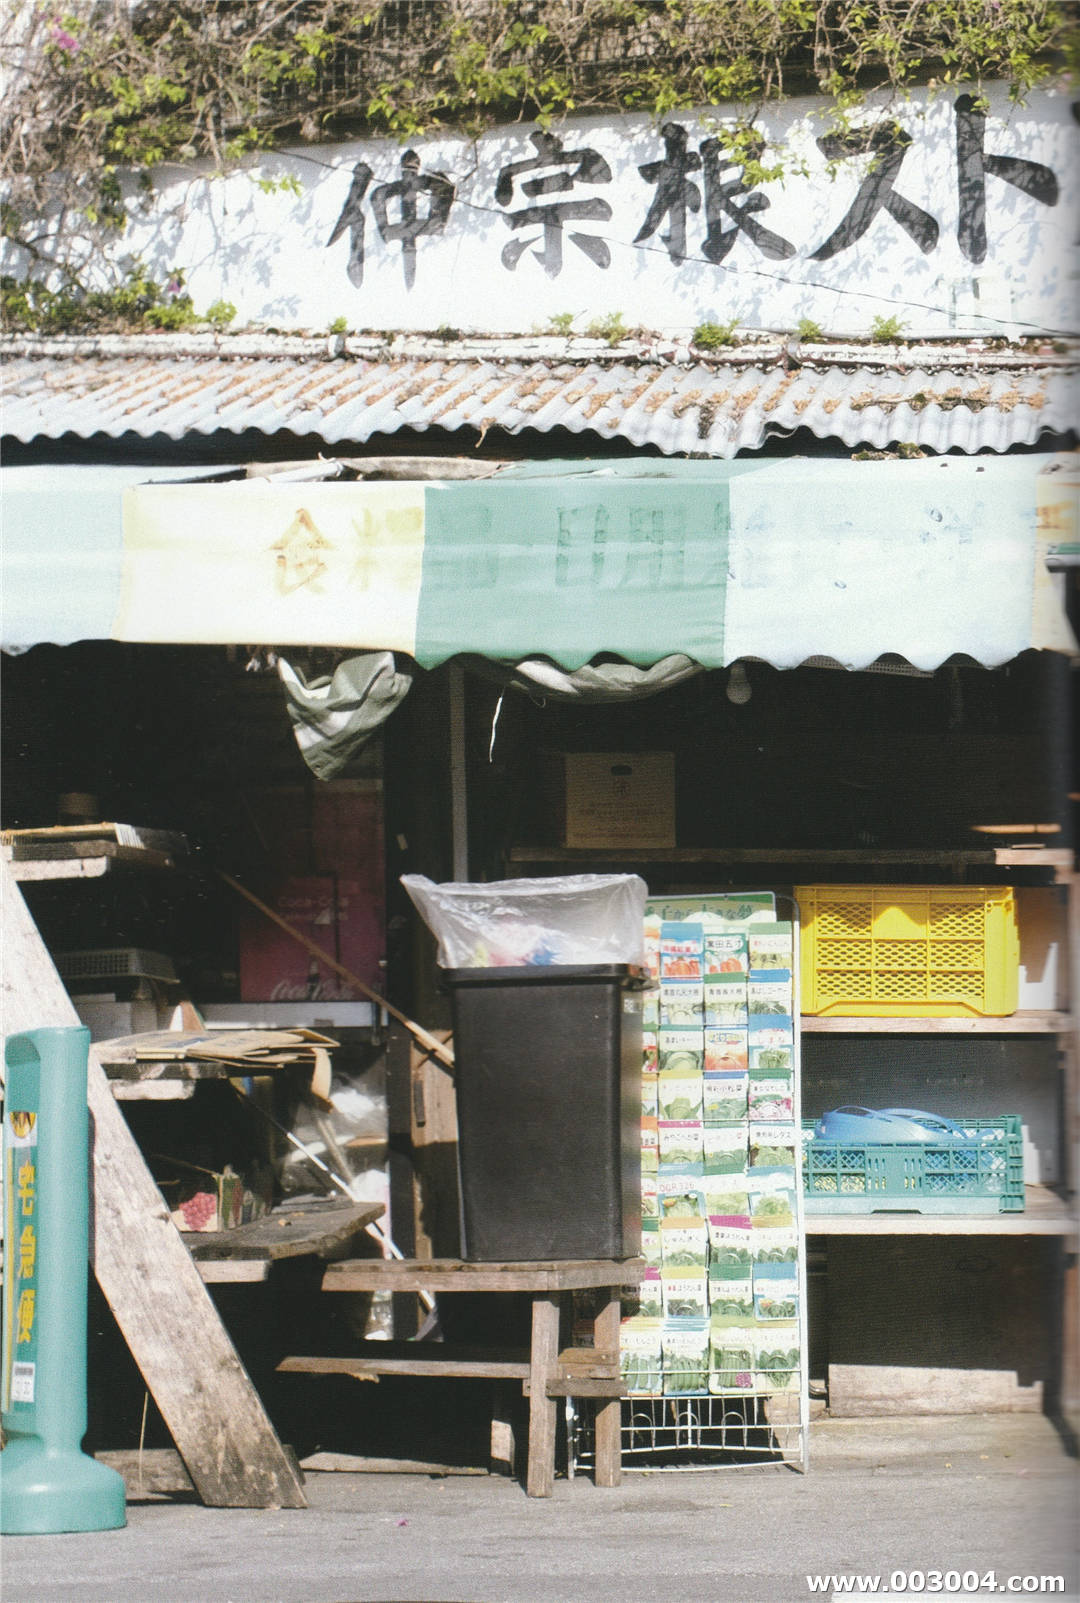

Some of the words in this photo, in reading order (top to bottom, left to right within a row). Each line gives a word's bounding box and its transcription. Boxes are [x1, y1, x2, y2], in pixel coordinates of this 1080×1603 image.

[328, 94, 1080, 290] 仲宗根スト
